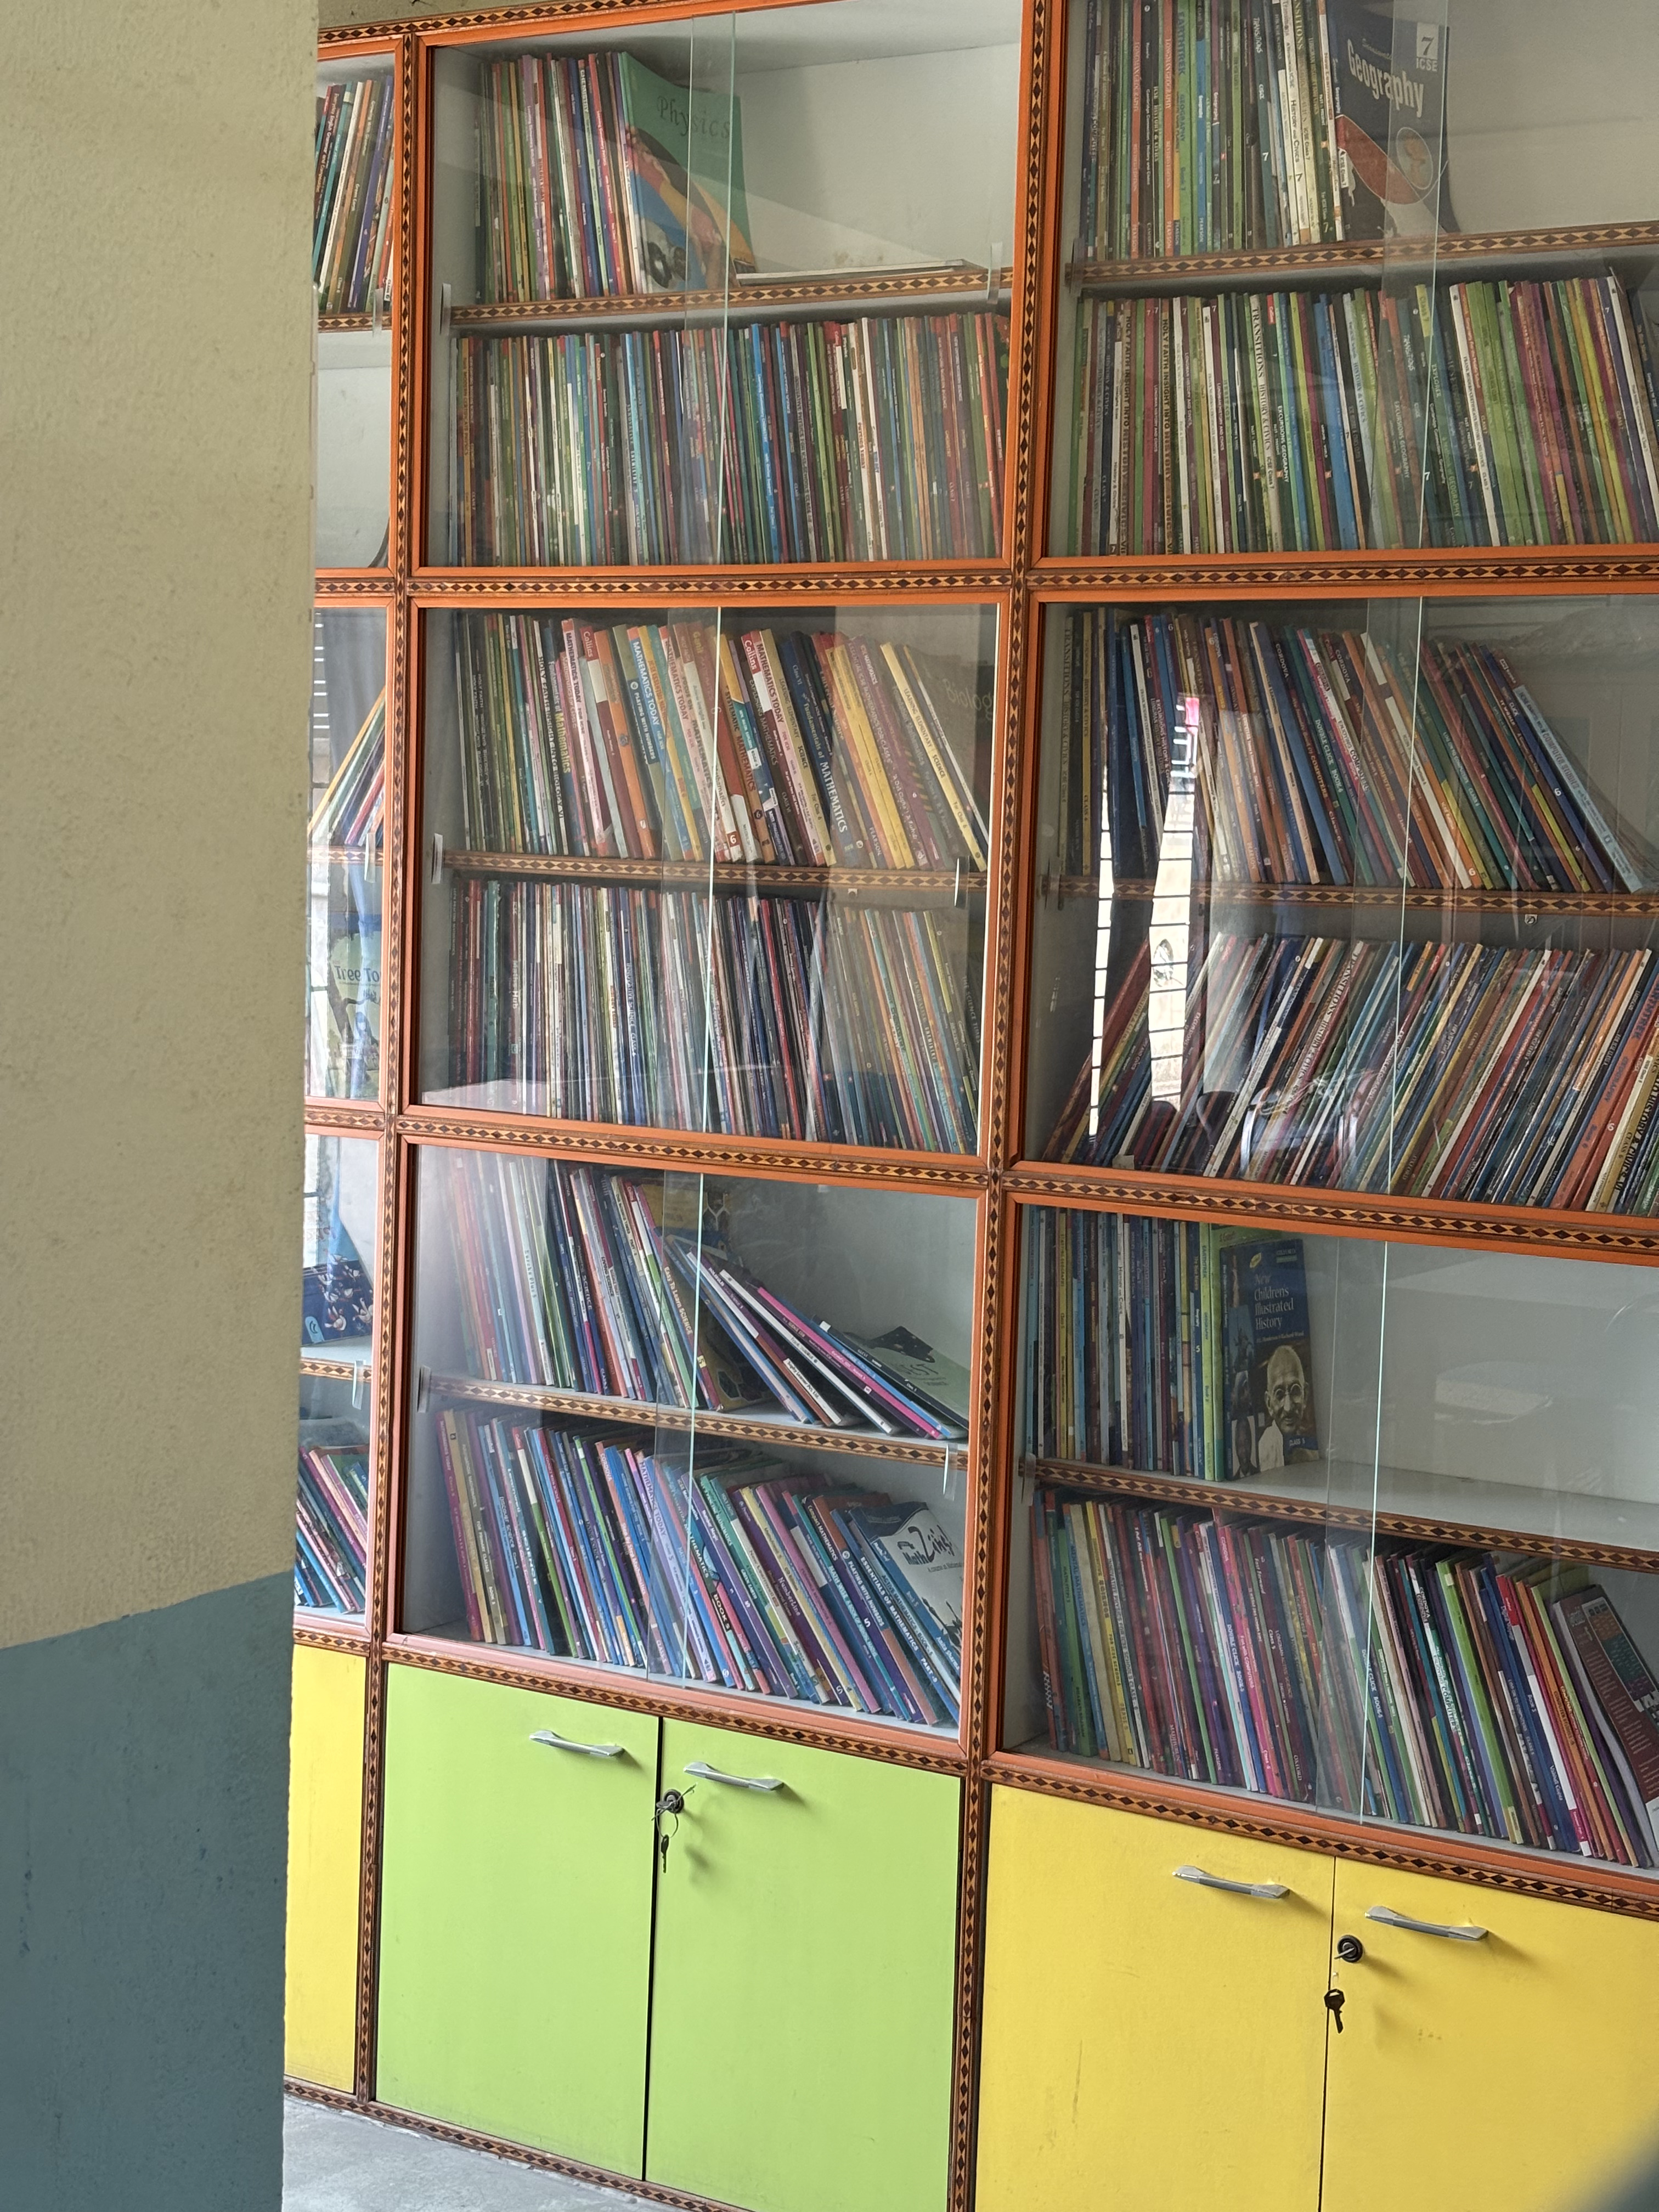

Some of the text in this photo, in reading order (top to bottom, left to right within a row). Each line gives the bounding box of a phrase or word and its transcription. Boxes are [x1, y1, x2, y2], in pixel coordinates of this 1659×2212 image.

[1177, 12, 1186, 75] EARTHTREK
[1420, 36, 1434, 55] 7
[1347, 39, 1425, 117] Geography
[1416, 58, 1438, 72] ICSE
[329, 93, 338, 114] Everyday
[580, 70, 589, 113] CHEMISTRY
[326, 115, 335, 131] English
[658, 96, 730, 138] Physics
[322, 132, 331, 154] Grammar
[1252, 308, 1265, 377] TRANSITIONS
[1259, 384, 1268, 416] HISTORY
[1263, 425, 1271, 450] CIVICS
[1277, 405, 1289, 482] EXCURSIONS GEOGRAPHY
[1395, 401, 1410, 478] EXCURSIONS GEOGRAPHY
[583, 631, 594, 657] Collins
[744, 640, 758, 671] Collins
[1062, 628, 1071, 695] TRANSITIONS
[1274, 643, 1290, 679] CORDOVA
[548, 661, 560, 704] Fundamentals
[566, 632, 581, 703] MATHEMATICS TODAY
[633, 641, 660, 726] MATHEMATICS TODAY
[757, 644, 784, 724] MATHEMATICS TODAY
[1335, 649, 1351, 684] CORDOVA
[634, 692, 656, 760] PLAYING WITH NUMBERS
[893, 685, 925, 766] Foundation Mathematics
[904, 688, 933, 748] LEARNING ELEMENTARY
[1507, 702, 1519, 717] CLICK
[556, 713, 572, 774] Mathematics
[797, 745, 809, 769] SCIENCE
[1315, 719, 1343, 793] DOUBLE CLICK BOOK-6
[1544, 732, 1579, 791] COMPUTER STUDIES
[736, 736, 756, 792] MATHEMATICS
[932, 754, 946, 780] SCIENCE
[1312, 755, 1328, 798] COMPUTERS
[1350, 749, 1371, 793] COMPUTERS
[821, 762, 847, 833] MATHEMATICS
[870, 827, 882, 856] PEARSON
[1246, 842, 1256, 869] PEARSON
[335, 966, 380, 981] Tree To
[1325, 952, 1359, 1016] TRANSITIONS
[966, 992, 975, 1020] SCIENCE
[972, 1023, 980, 1044] TIMES
[1183, 1012, 1201, 1046] EXCURSIONS
[1310, 1019, 1328, 1049] HISTORY
[958, 1020, 976, 1091] Cambridge Connection Chemistry
[1297, 1057, 1313, 1080] CIVICS
[1366, 1030, 1405, 1101] EXCURSIONS GEOGRAPHY
[1602, 1056, 1629, 1104] GEOGRAPHY
[1634, 1095, 1657, 1136] HISTORY
[1620, 1131, 1632, 1150] CLASS
[1401, 1154, 1419, 1181] OXFORD
[1642, 1185, 1656, 1210] PEARSON
[524, 1250, 534, 1276] Eureka
[1254, 1273, 1271, 1285] New
[583, 1275, 592, 1311] SCIENCE
[664, 1266, 674, 1279] Easy
[672, 1290, 684, 1308] Learn
[679, 1308, 693, 1335] SCIENCE
[1255, 1286, 1289, 1301] Children's
[1255, 1298, 1294, 1316] Illustrated
[1255, 1317, 1283, 1330] History
[462, 1444, 471, 1474] FOUNDATION
[468, 1476, 477, 1508] MATHEMATICS
[600, 1453, 613, 1482] CORDOVA
[639, 1460, 667, 1537] MATHEMATICS TODAY
[500, 1496, 515, 1548] DISCOVER SCIENCE
[808, 1505, 838, 1562] Compact MATHEMATICS
[522, 1530, 537, 1585] SCIENCE
[1221, 1536, 1230, 1562] CORDOVA
[778, 1576, 801, 1617] NumberLine
[1070, 1545, 1086, 1627] MENTAL MATHEMATICS
[1099, 1579, 1110, 1618] SCIENCE
[1256, 1572, 1266, 1594] Forward
[1419, 1587, 1430, 1618] CORDOVA
[713, 1593, 726, 1620] BOOK
[860, 1556, 887, 1595] ESSENTIALS
[888, 1605, 918, 1651] MATHEMATICS
[936, 1635, 961, 1671] Anita Sharma
[1441, 1685, 1457, 1731] COMPUTERS
[1527, 1694, 1535, 1707] Book
[1293, 1754, 1302, 1781] OXFORD
